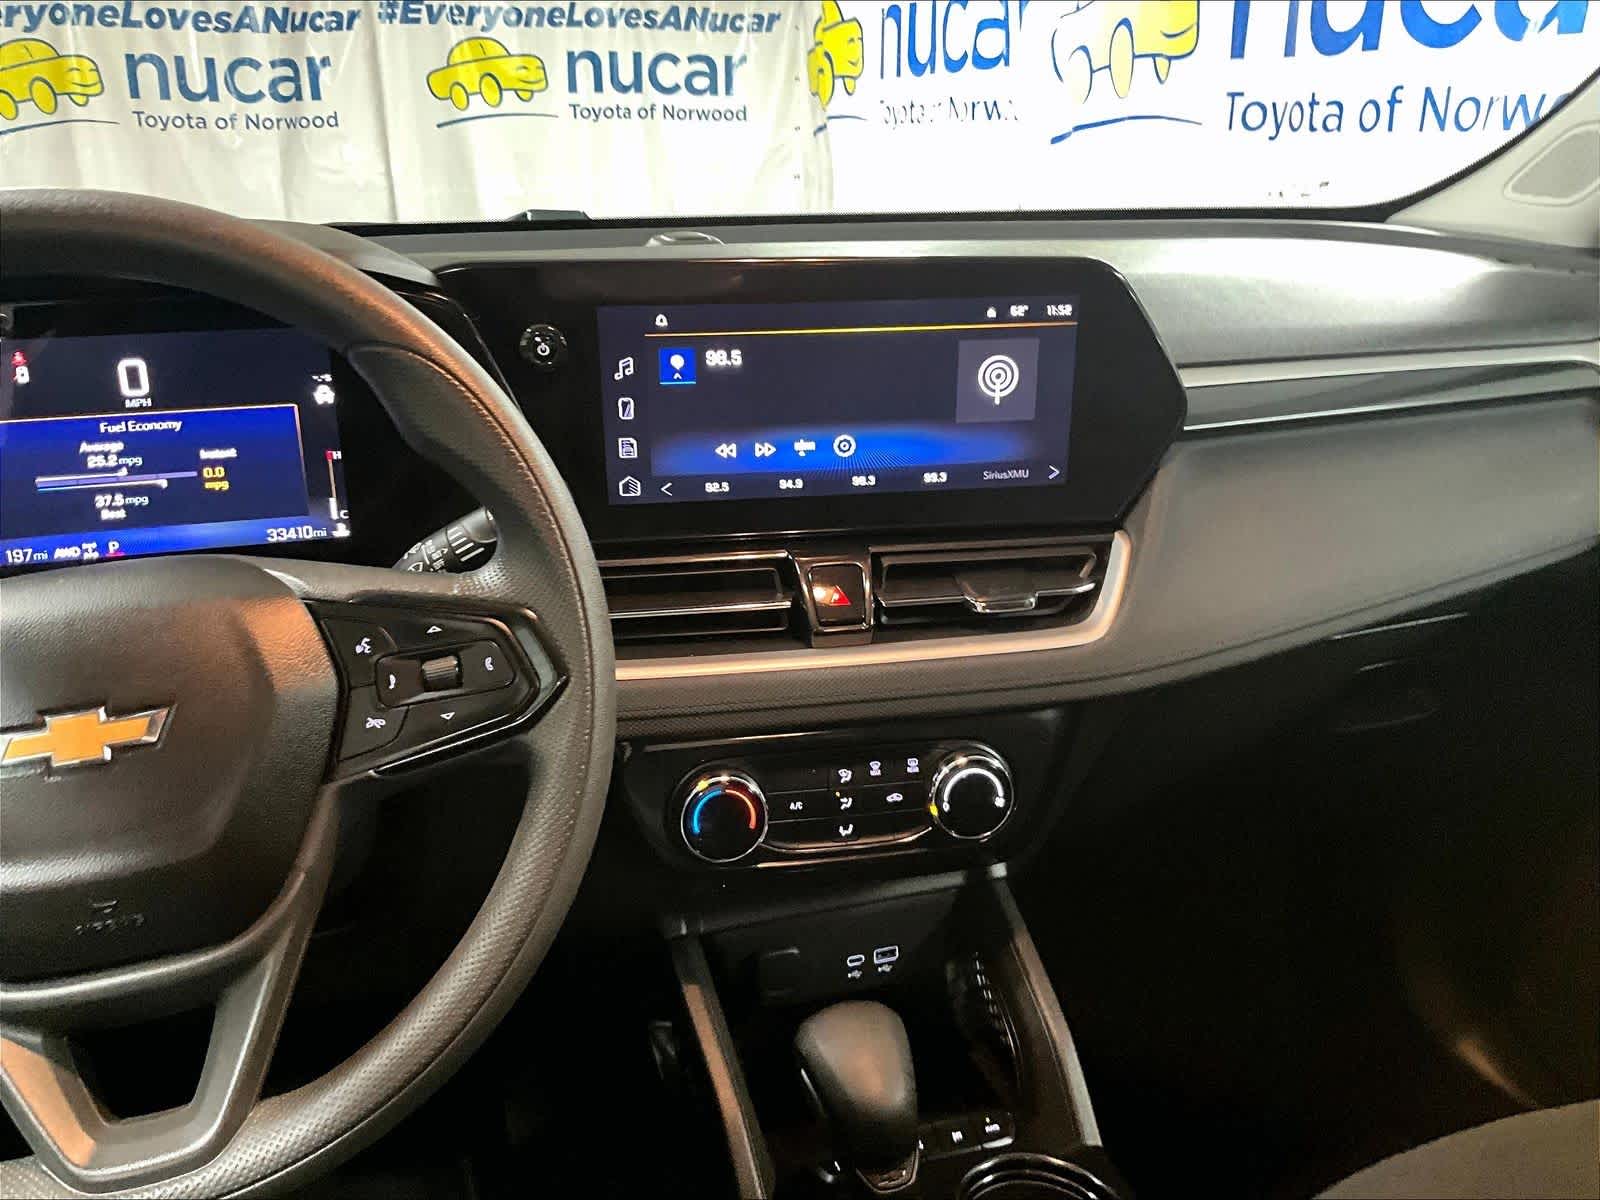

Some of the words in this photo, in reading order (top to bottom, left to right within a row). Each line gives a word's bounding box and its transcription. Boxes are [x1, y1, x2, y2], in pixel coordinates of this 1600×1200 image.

[0, 2, 361, 34] ryoneLovesANucar
[377, 0, 782, 33] #EveryoneLovesANucar
[124, 52, 332, 104] nucar
[566, 49, 747, 96] nucar
[132, 111, 207, 131] Toyota
[215, 112, 238, 130] of
[244, 112, 339, 130] Norwood
[568, 103, 632, 122] Toyota
[640, 103, 657, 120] of
[664, 103, 747, 121] Norwood
[1226, 92, 1344, 141] Toyota
[1359, 86, 1404, 132] of
[1418, 86, 1568, 133] Norw
[100, 421, 126, 433] Fuel
[127, 420, 182, 432] Economy
